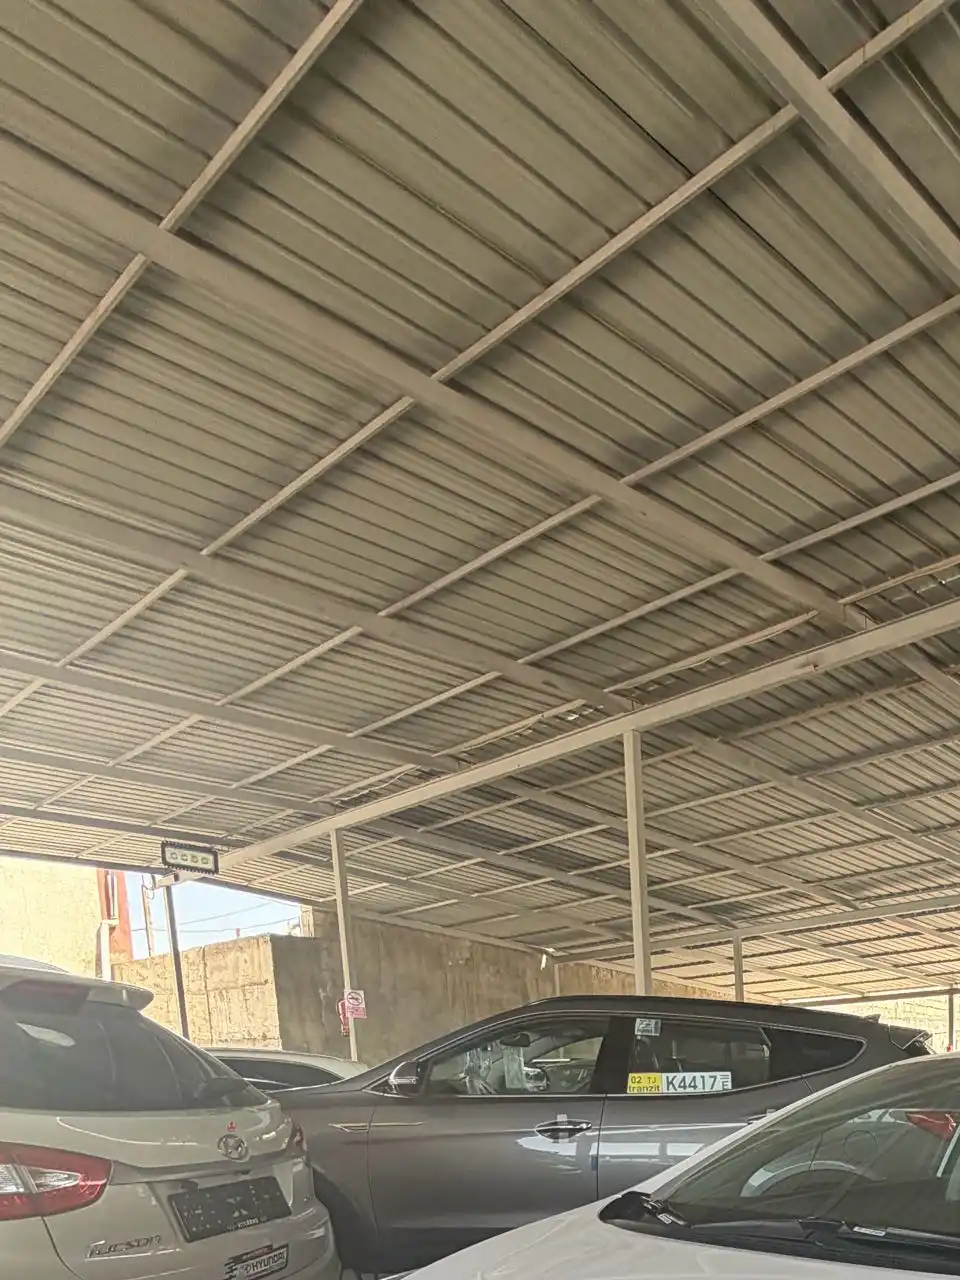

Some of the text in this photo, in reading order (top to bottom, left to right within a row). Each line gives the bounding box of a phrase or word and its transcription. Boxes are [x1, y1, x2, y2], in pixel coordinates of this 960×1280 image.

[631, 1076, 657, 1084] 02 TJ
[665, 1075, 718, 1092] K4417
[628, 1084, 660, 1092] tranzit
